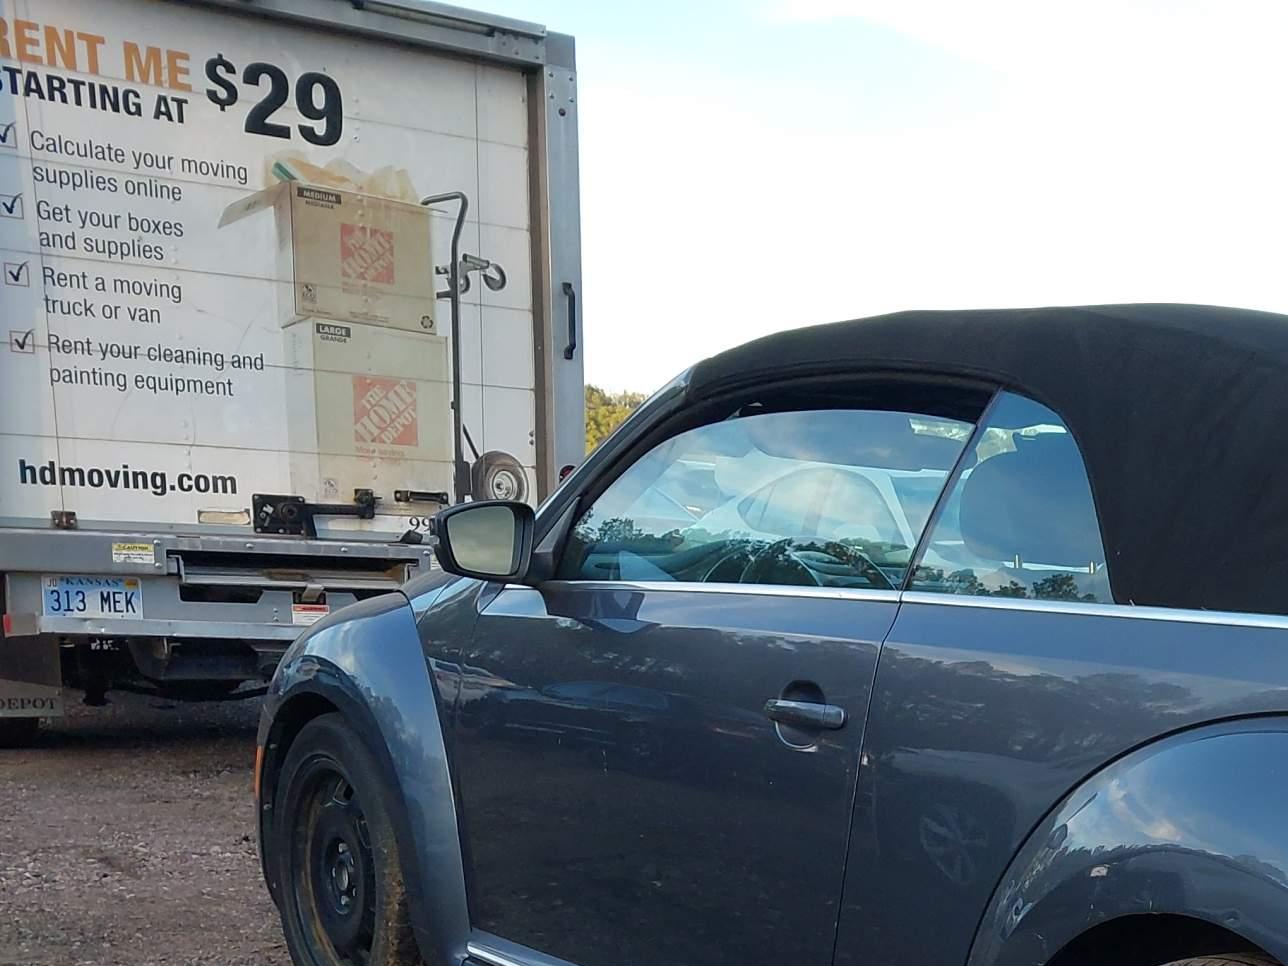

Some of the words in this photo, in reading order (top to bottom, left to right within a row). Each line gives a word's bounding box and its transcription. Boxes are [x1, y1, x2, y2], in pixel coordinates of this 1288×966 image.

[123, 40, 192, 92] ME
[0, 65, 142, 117] TARTING
[153, 94, 188, 124] AT
[205, 52, 343, 147] $29
[31, 130, 125, 163] Calculate
[132, 149, 174, 170] your
[181, 158, 248, 185] moving
[33, 166, 118, 192] supplies
[125, 179, 182, 201] online
[303, 190, 337, 201] MEDIUM
[37, 200, 71, 223] Get
[78, 209, 121, 230] your
[128, 212, 184, 237] boxes
[39, 231, 76, 250] and
[83, 236, 164, 260] supplies
[43, 266, 88, 290] Rent
[95, 276, 106, 292] a
[114, 278, 182, 303] moving
[44, 295, 96, 318] truck
[102, 303, 121, 320] or
[127, 307, 161, 324] van
[320, 324, 347, 336] LARGE
[48, 333, 93, 356] Rent
[98, 342, 141, 361] your
[147, 344, 224, 370] cleaning
[231, 353, 264, 370] and
[50, 365, 127, 391] painting
[134, 374, 233, 397] equipment
[355, 380, 416, 442] HOME
[381, 405, 417, 444] DEPOT
[18, 459, 238, 496] hdmoving.com
[65, 577, 119, 587] KANSAS
[50, 590, 86, 612] 313
[100, 590, 136, 613] MEK
